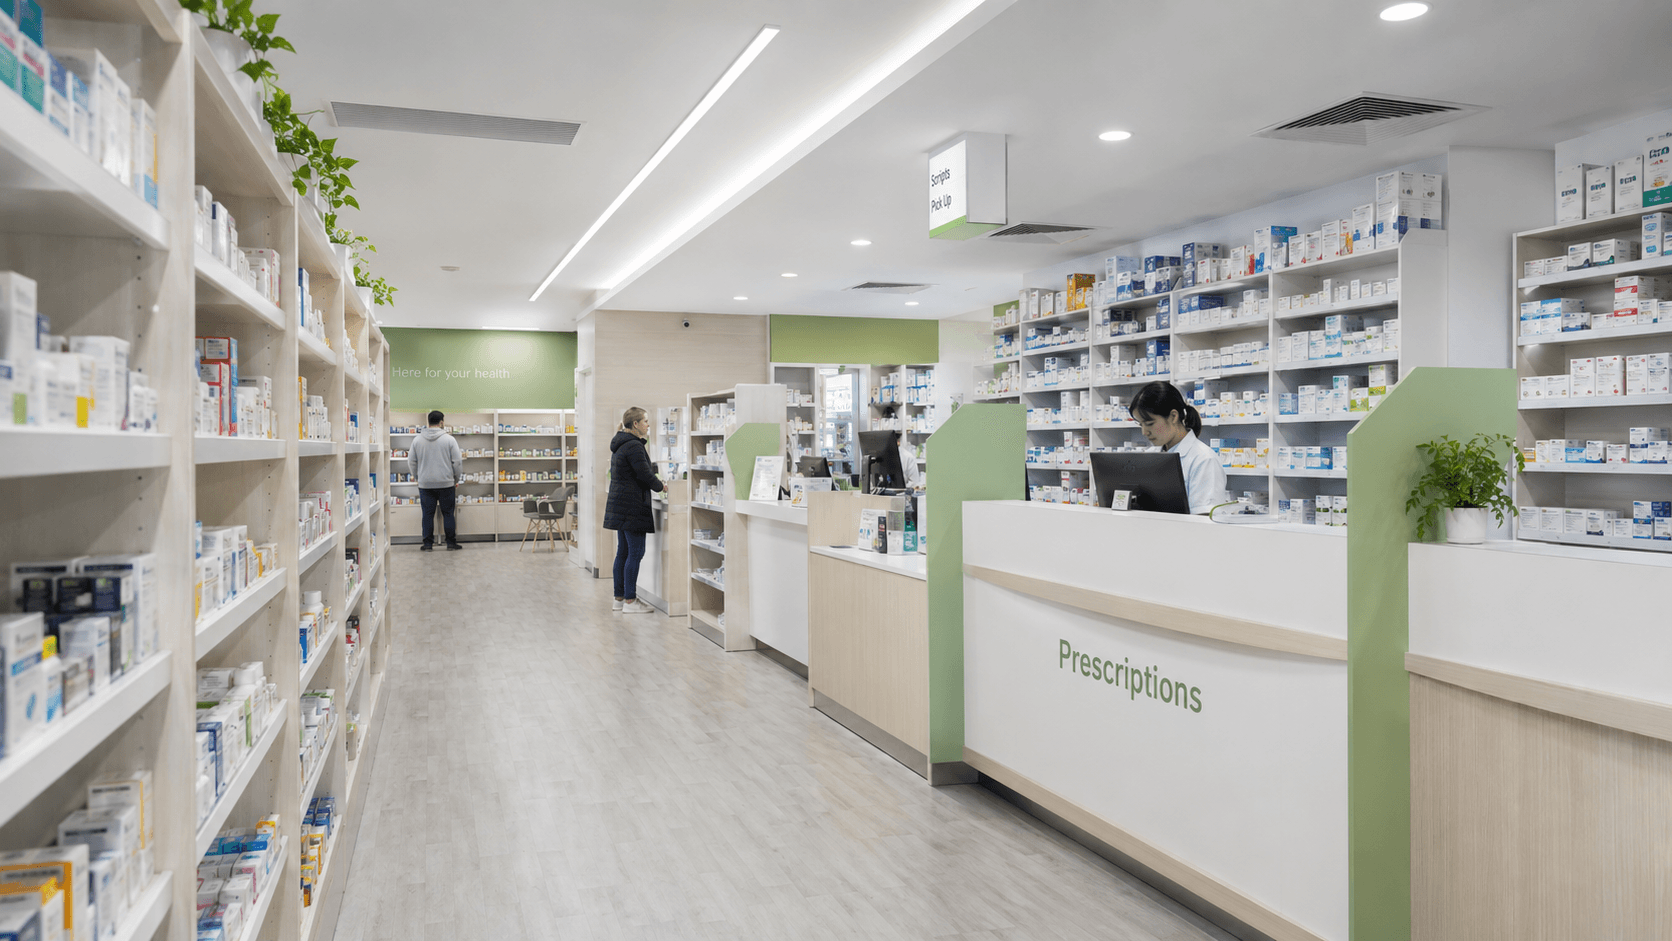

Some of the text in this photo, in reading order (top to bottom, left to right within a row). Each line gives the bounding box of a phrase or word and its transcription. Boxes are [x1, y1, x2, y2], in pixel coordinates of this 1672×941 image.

[931, 168, 951, 187] Scripts
[931, 194, 952, 213] Pick Up
[392, 367, 510, 380] Here for your health
[1059, 638, 1203, 714] Prescriptions
